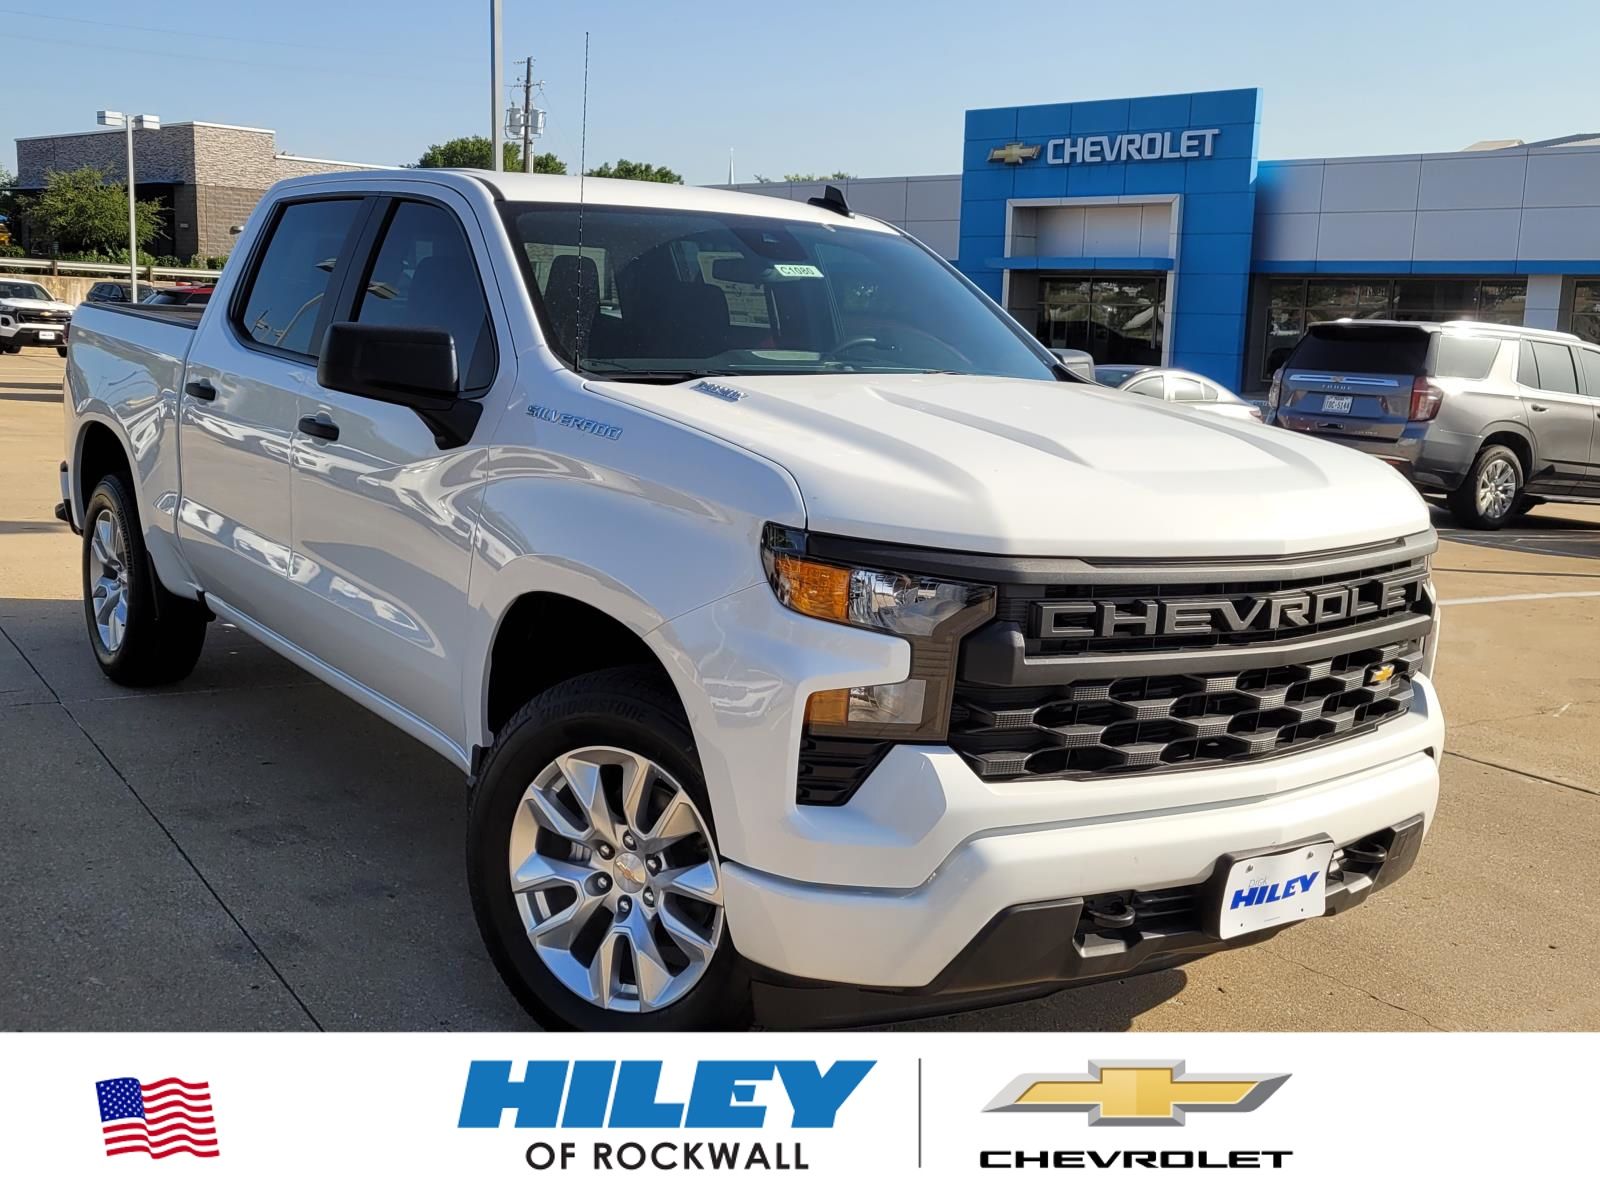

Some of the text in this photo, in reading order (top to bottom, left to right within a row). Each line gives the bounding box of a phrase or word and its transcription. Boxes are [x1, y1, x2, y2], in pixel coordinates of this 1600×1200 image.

[1046, 128, 1221, 165] CHEVROLET
[780, 266, 815, 276] C1080
[526, 405, 623, 440] SILVERADO
[1038, 573, 1429, 638] CHEVROLET
[1230, 871, 1320, 910] HILEY
